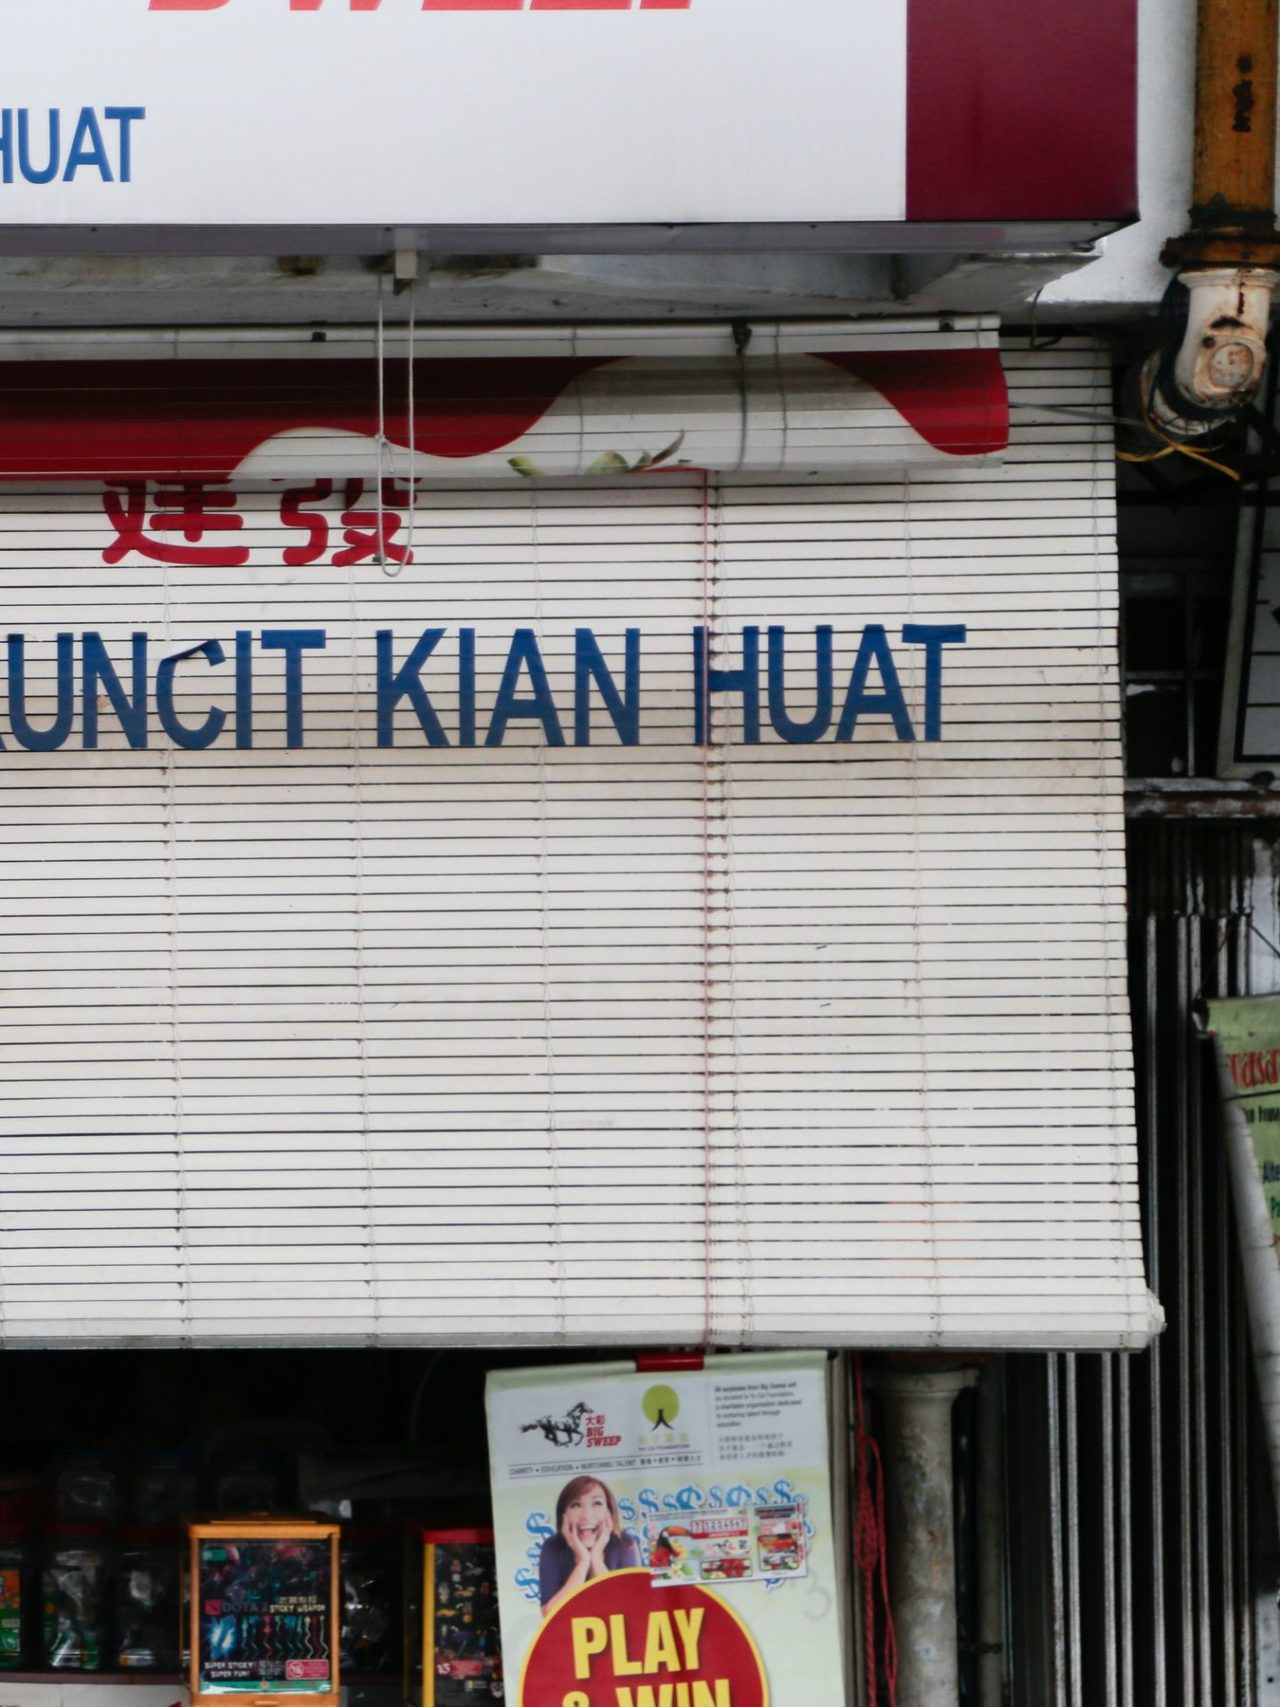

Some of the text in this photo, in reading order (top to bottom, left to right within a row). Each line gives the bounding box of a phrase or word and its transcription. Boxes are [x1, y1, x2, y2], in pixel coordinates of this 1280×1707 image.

[376, 626, 641, 746] KIAN
[693, 623, 967, 742] HUAT
[586, 1426, 605, 1438] BIG
[586, 1435, 622, 1448] SWEEP
[571, 1607, 705, 1680] PLAY
